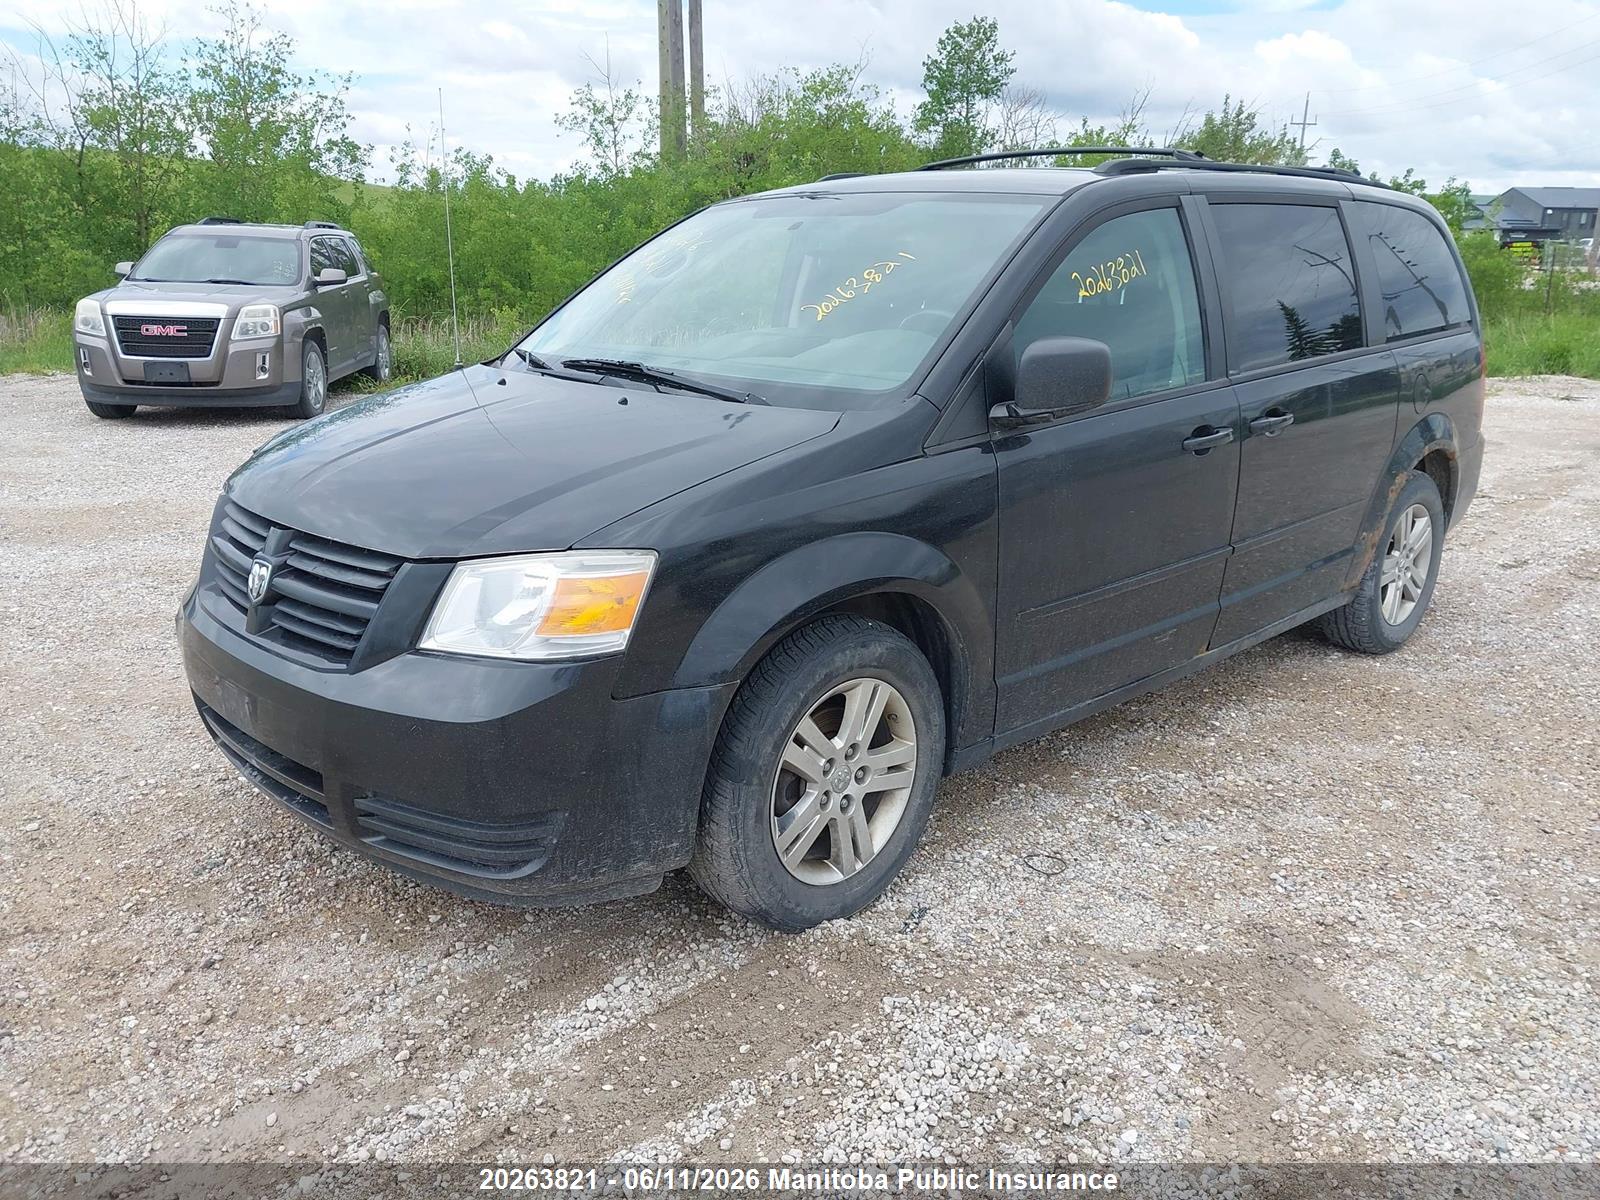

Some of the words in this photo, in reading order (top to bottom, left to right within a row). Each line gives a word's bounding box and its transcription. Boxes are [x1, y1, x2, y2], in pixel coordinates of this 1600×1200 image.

[800, 251, 917, 321] 20263821
[1071, 249, 1147, 297] 20263821
[140, 324, 188, 337] GMC
